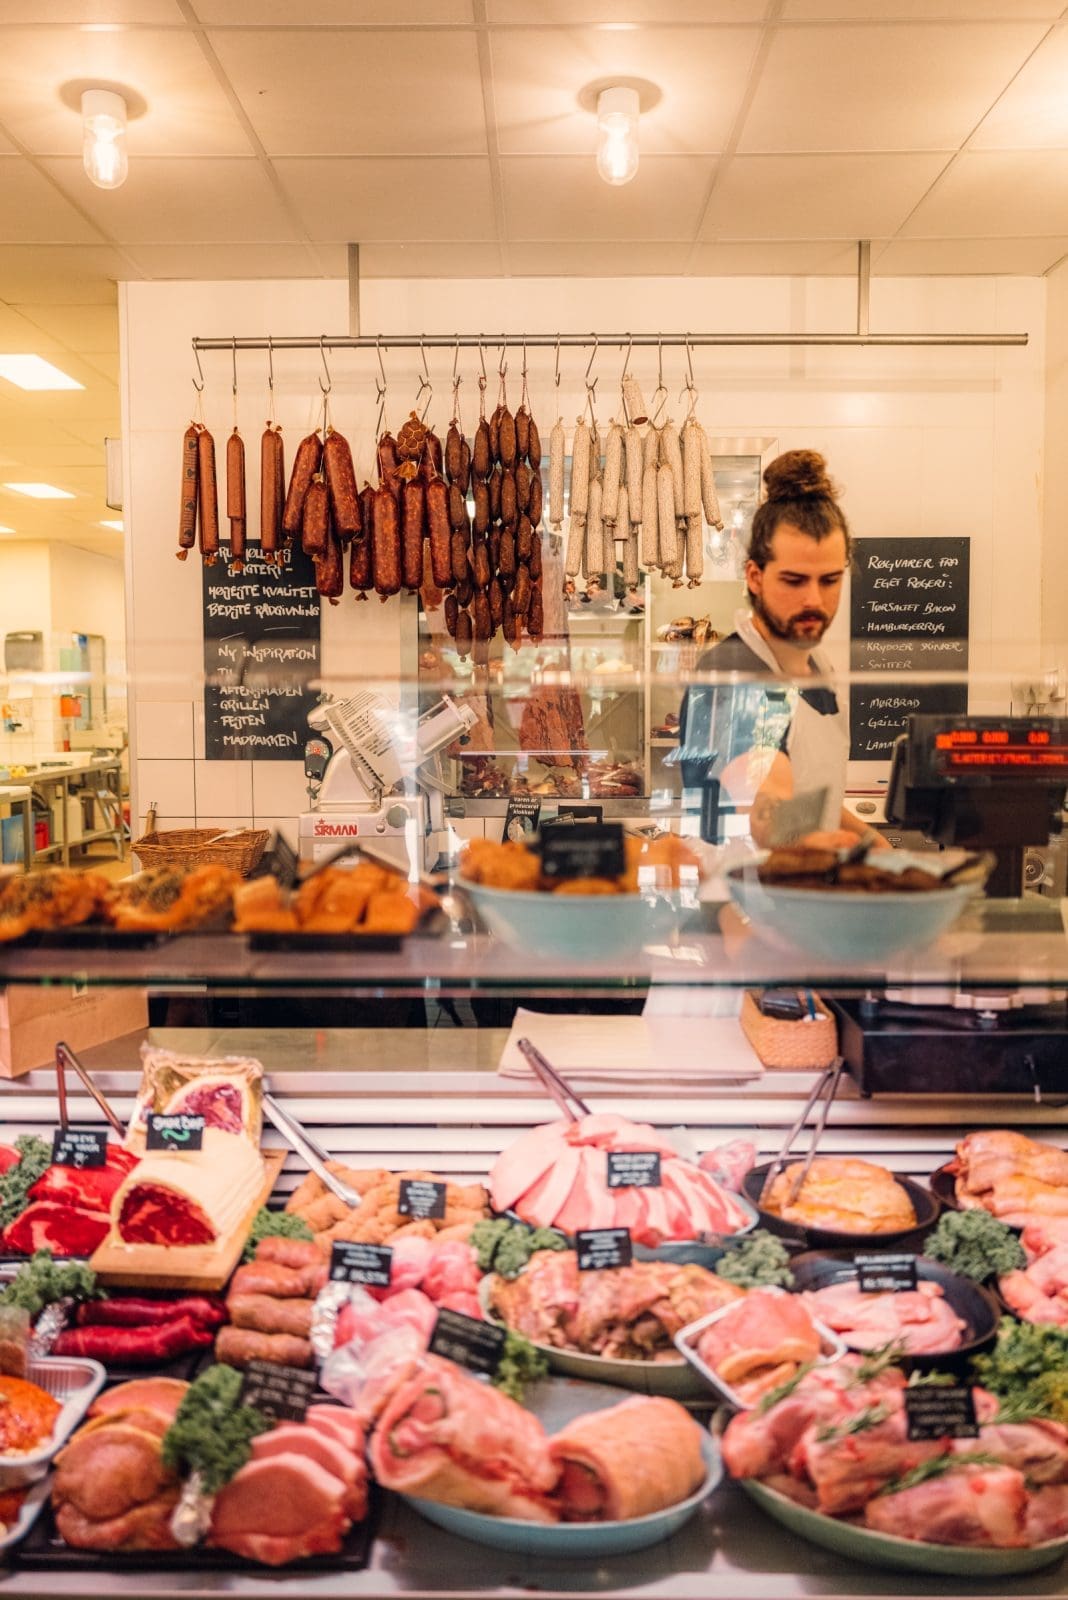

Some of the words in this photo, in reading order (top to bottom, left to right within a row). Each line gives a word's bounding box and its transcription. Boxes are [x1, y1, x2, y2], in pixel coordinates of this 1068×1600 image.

[873, 577, 903, 589] EGET
[208, 585, 260, 600] HØJESTE
[206, 603, 251, 620] BEDSTE
[922, 602, 957, 615] BACON
[867, 622, 946, 634] HAMBURGERRYG
[218, 645, 237, 662] NY
[866, 641, 914, 654] KRYDDER
[219, 698, 270, 712] GRILLEN
[869, 697, 921, 709] MØRBRAD
[220, 713, 266, 730] FESTEN
[223, 731, 298, 747] MADPAKKEN
[314, 825, 358, 836] SIRMAN
